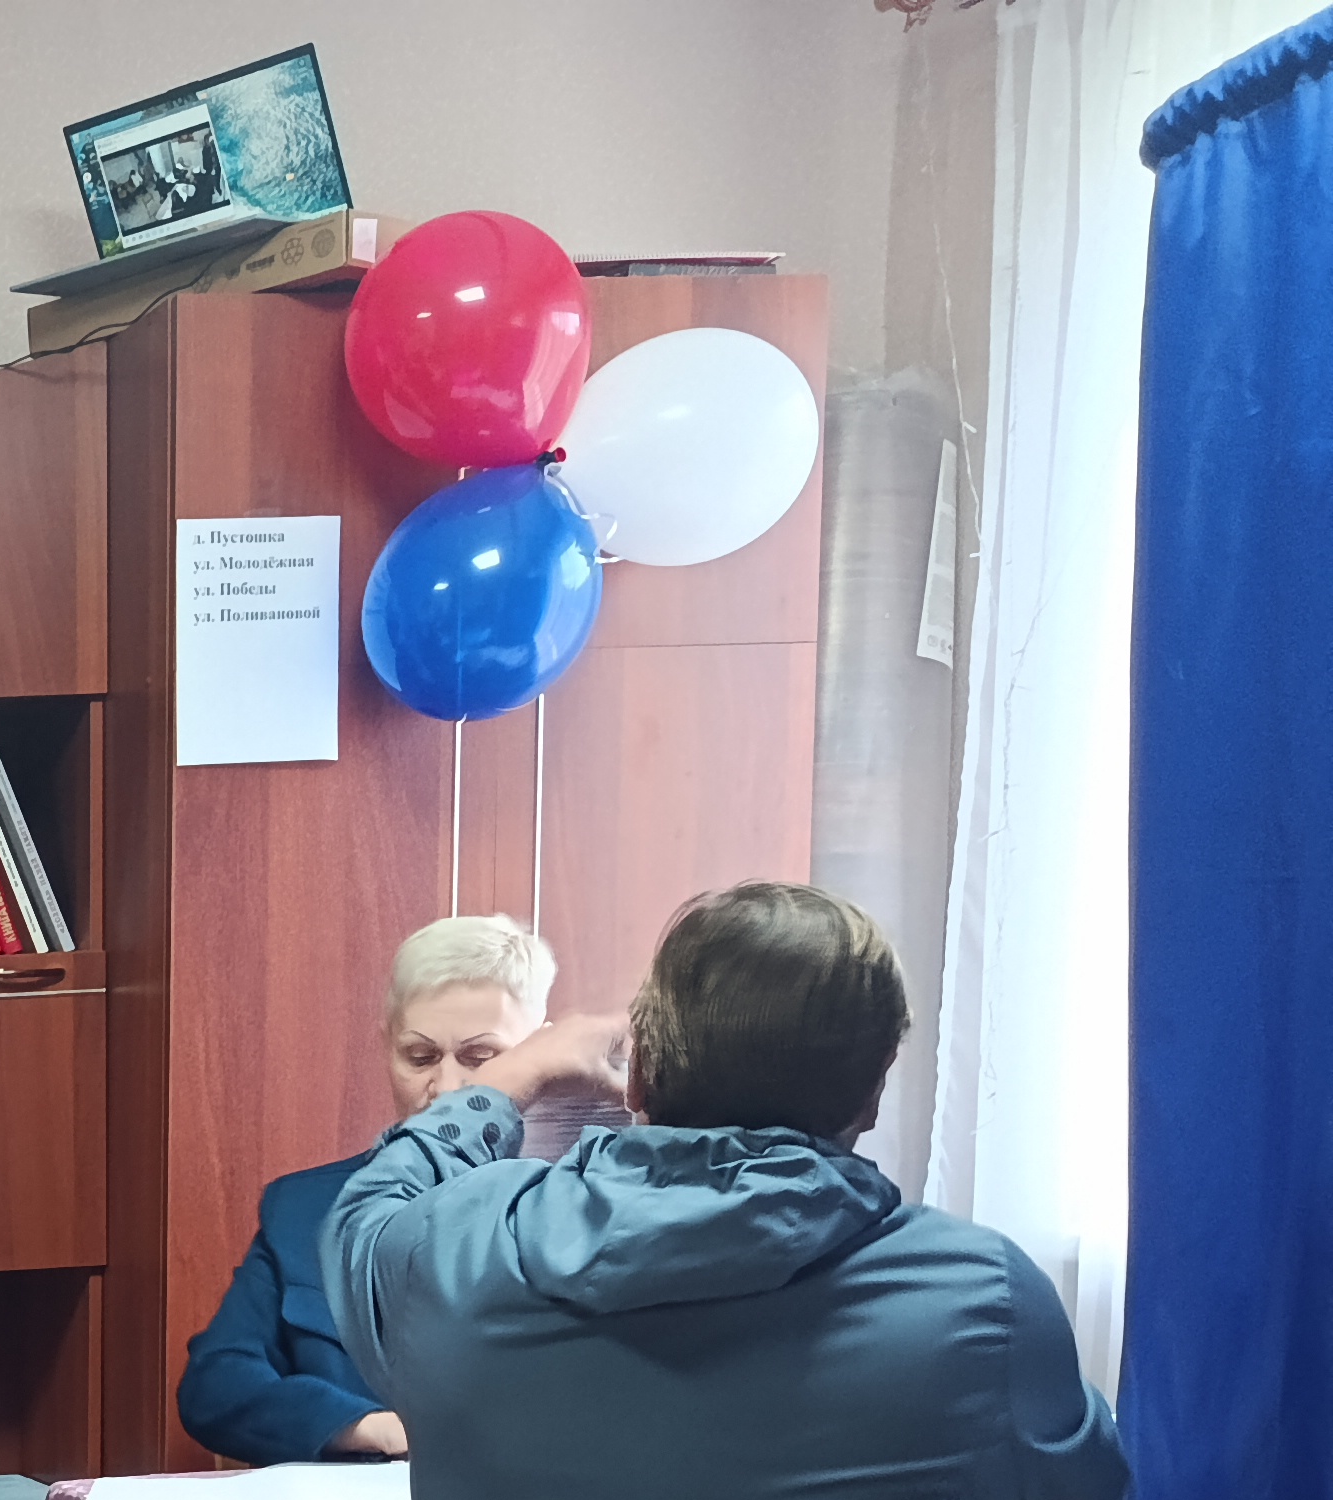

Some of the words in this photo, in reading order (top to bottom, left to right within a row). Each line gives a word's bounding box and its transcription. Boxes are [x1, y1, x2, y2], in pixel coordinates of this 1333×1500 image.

[193, 535, 205, 544] д.
[211, 531, 284, 547] Пустошка
[194, 561, 214, 574] ул.
[220, 557, 313, 569] Молодёжная
[194, 587, 215, 600] ул.
[221, 582, 276, 595] Победы
[194, 613, 215, 626] ул.
[221, 606, 320, 622] Поливановой
